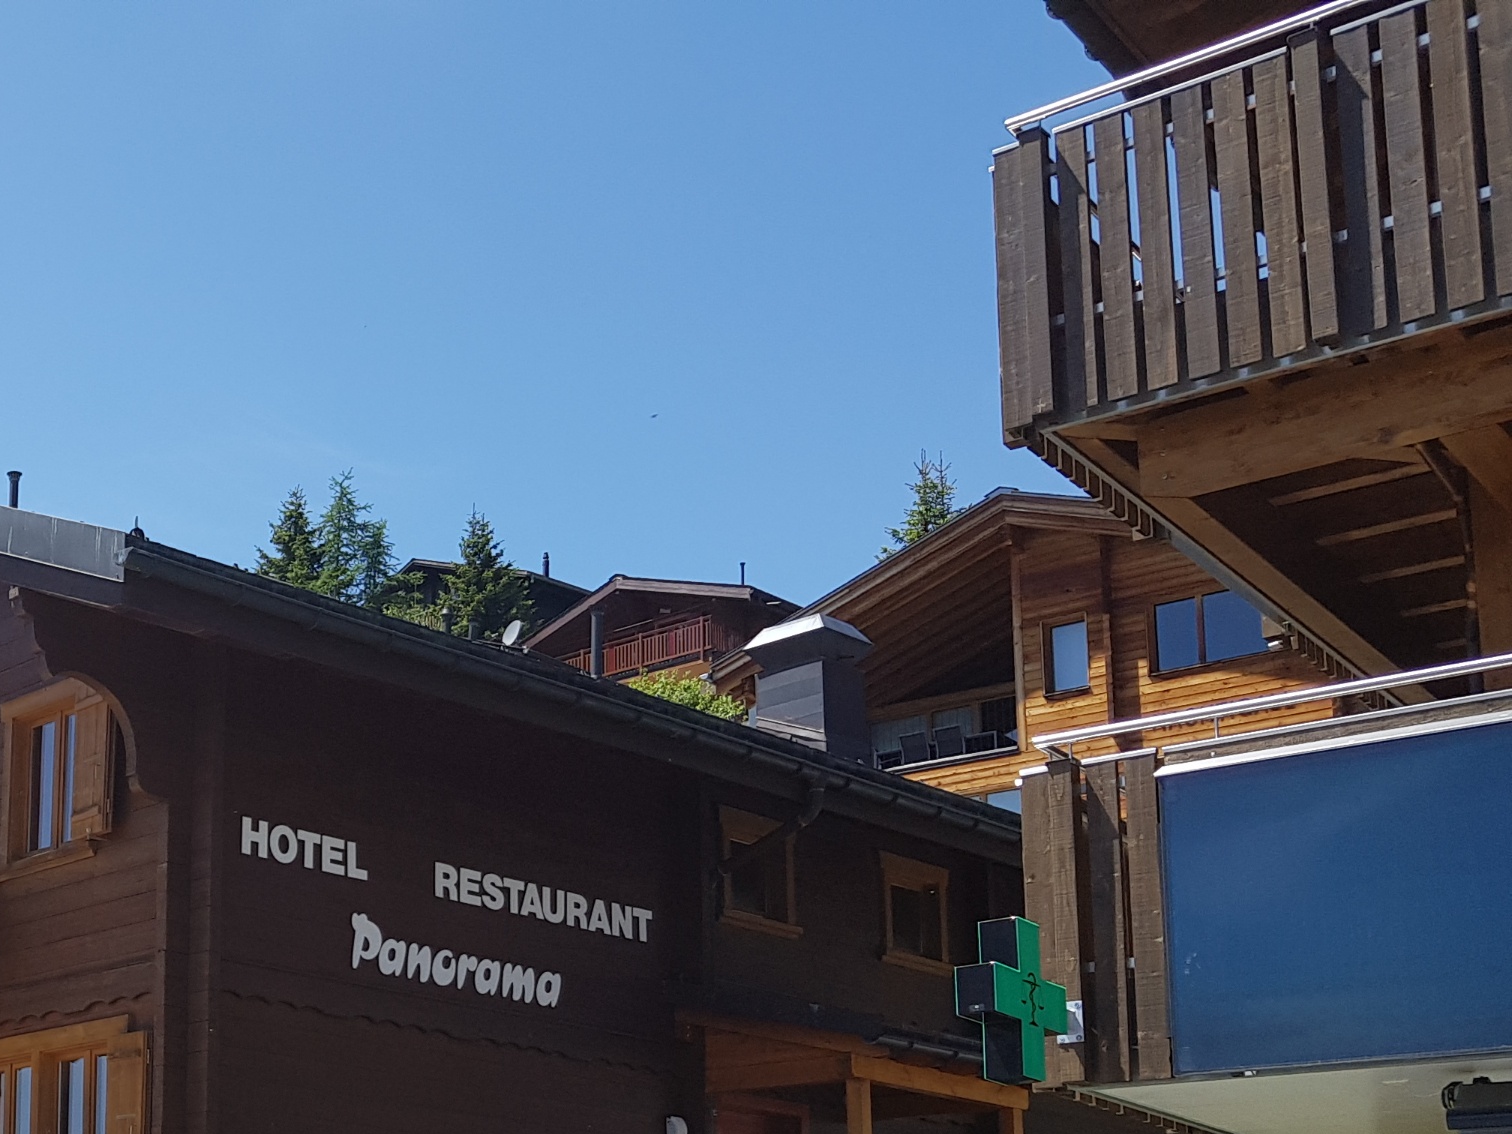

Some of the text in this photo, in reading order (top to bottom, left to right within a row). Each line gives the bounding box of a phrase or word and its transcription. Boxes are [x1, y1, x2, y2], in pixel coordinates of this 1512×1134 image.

[241, 815, 652, 943] HOTEL RESTAURANT
[351, 912, 562, 1008] Panorama
